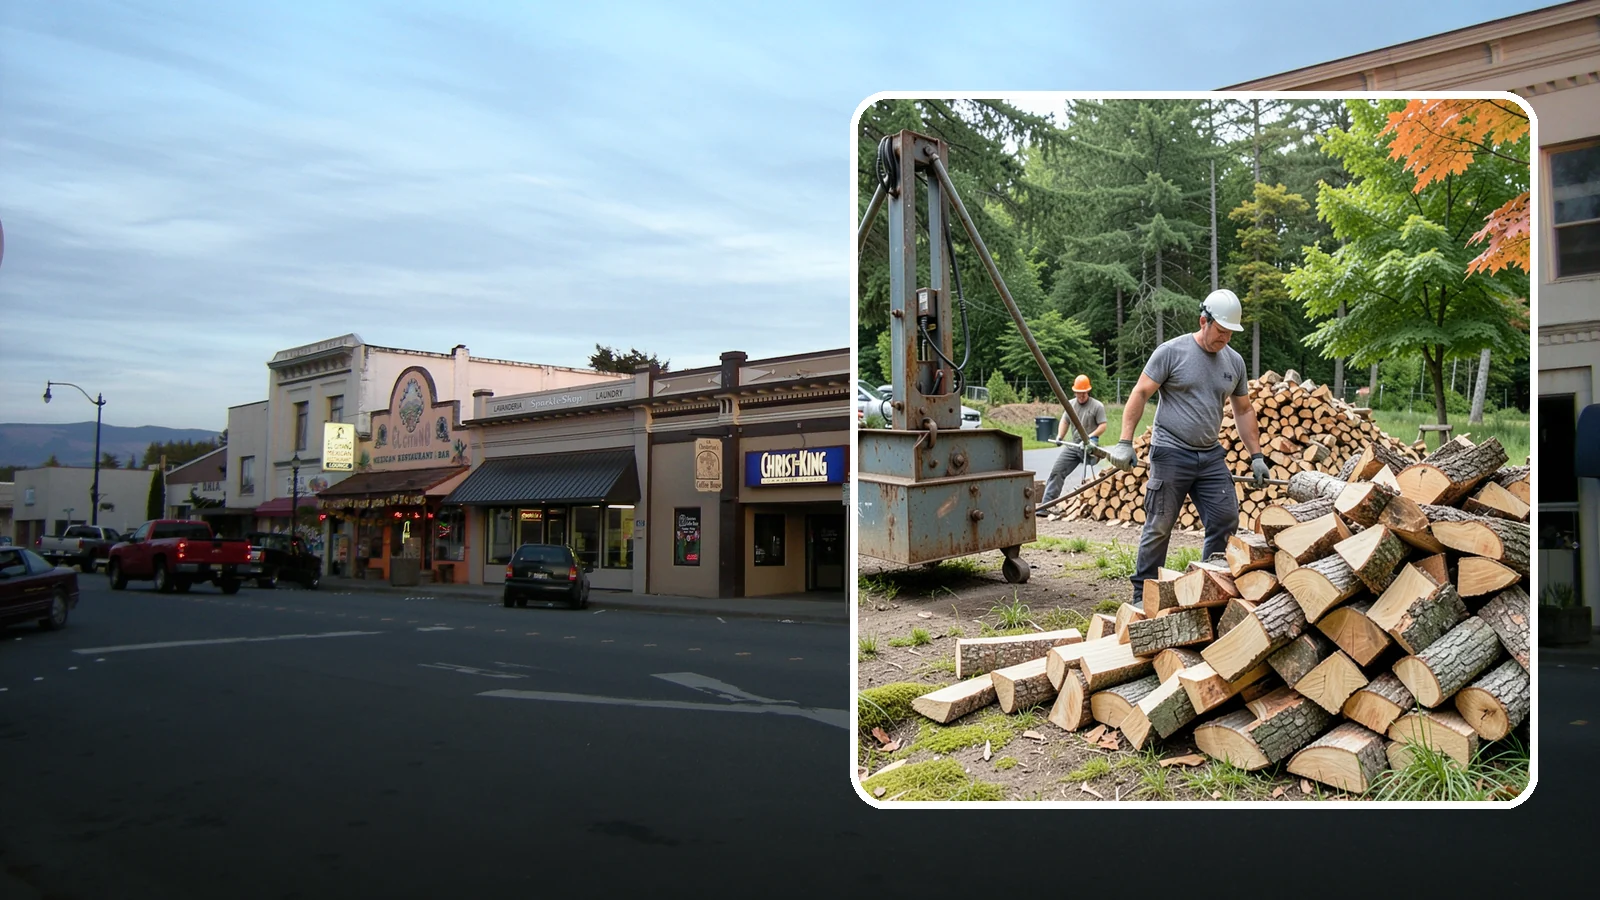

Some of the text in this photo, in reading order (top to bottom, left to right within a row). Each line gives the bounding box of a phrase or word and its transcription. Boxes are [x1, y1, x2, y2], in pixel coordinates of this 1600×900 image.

[595, 389, 623, 400] LAUNDRY
[493, 402, 522, 412] LAVANDERIA
[530, 394, 582, 409] Sparkle Shop
[373, 455, 396, 464] MEXICAN
[397, 451, 434, 462] RESTAURANT
[438, 450, 450, 459] BAR
[760, 450, 827, 478] CHRIST KING
[696, 481, 721, 489] Coffee House
